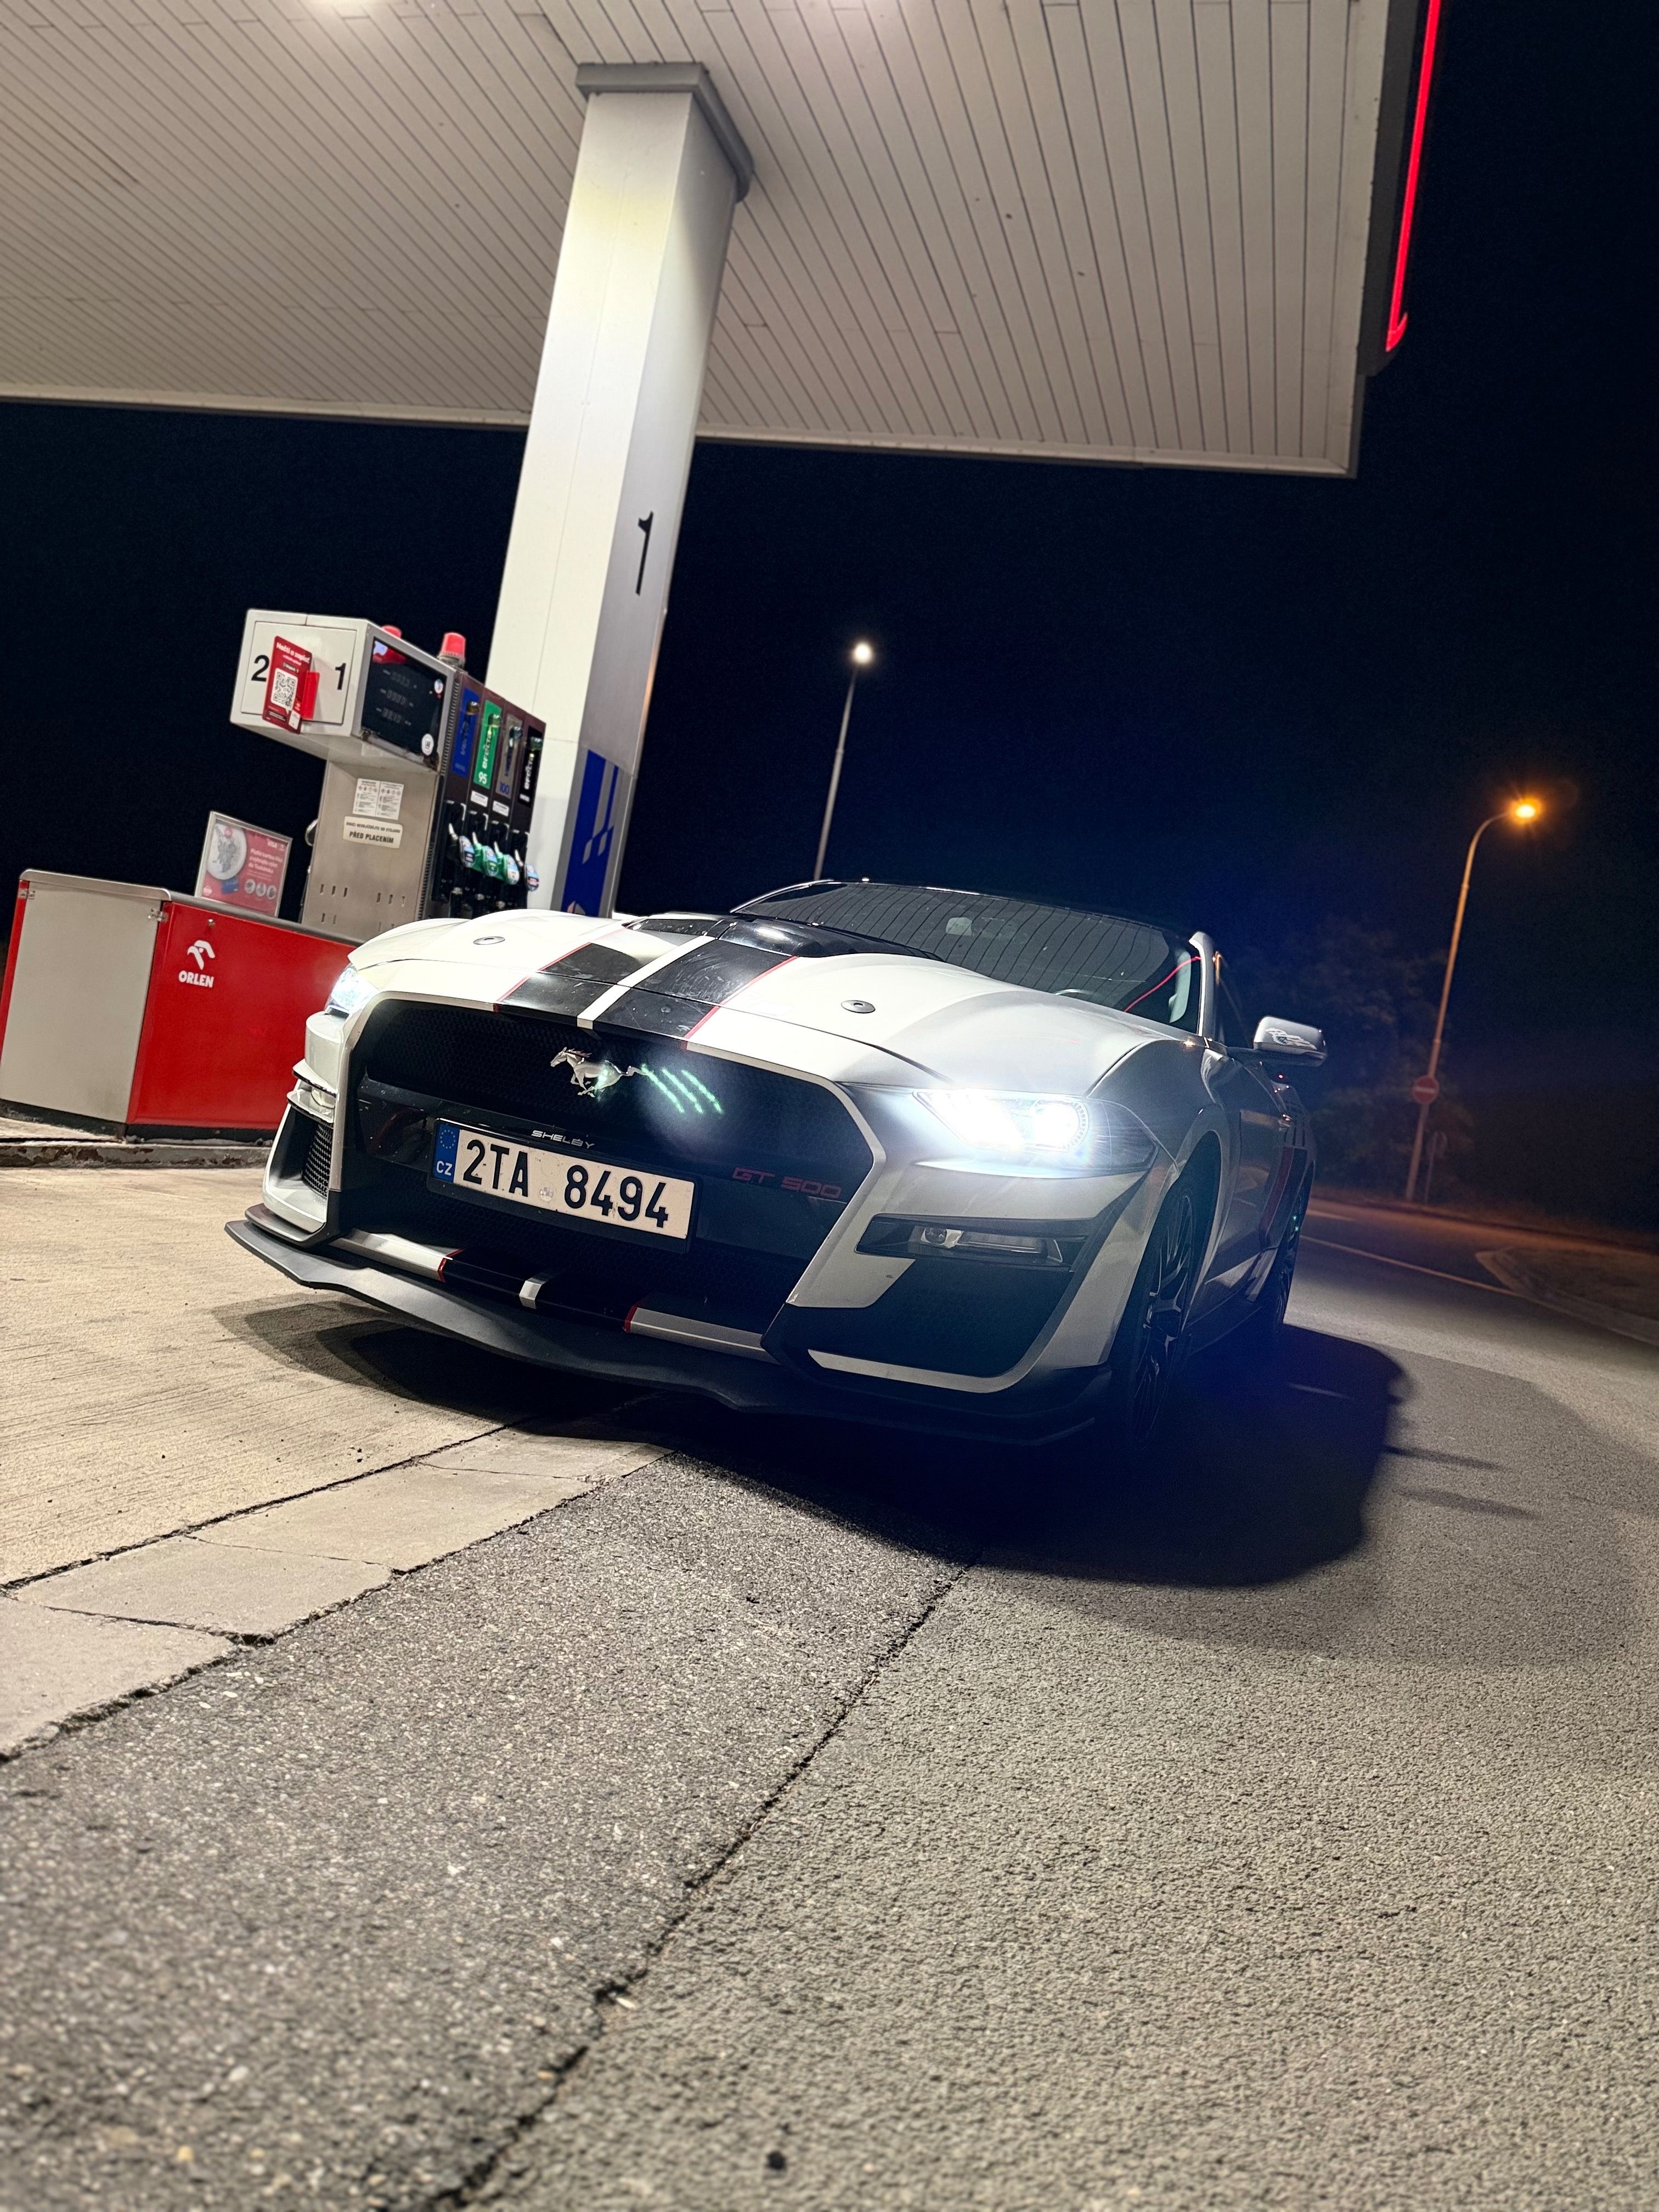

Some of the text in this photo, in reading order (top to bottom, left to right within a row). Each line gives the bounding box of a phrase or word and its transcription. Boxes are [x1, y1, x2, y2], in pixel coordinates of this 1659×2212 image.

[635, 511, 654, 596] 1
[251, 654, 269, 682] 2
[335, 663, 346, 690] 1
[478, 771, 487, 785] 95
[500, 782, 510, 795] 100
[349, 830, 394, 843] PŘED PLACENÍM
[178, 970, 214, 988] ORLEN
[531, 1130, 595, 1149] SHELBY
[436, 1160, 453, 1176] CZ
[462, 1139, 669, 1228] 2TA 8494
[732, 1167, 842, 1199] GT 500
